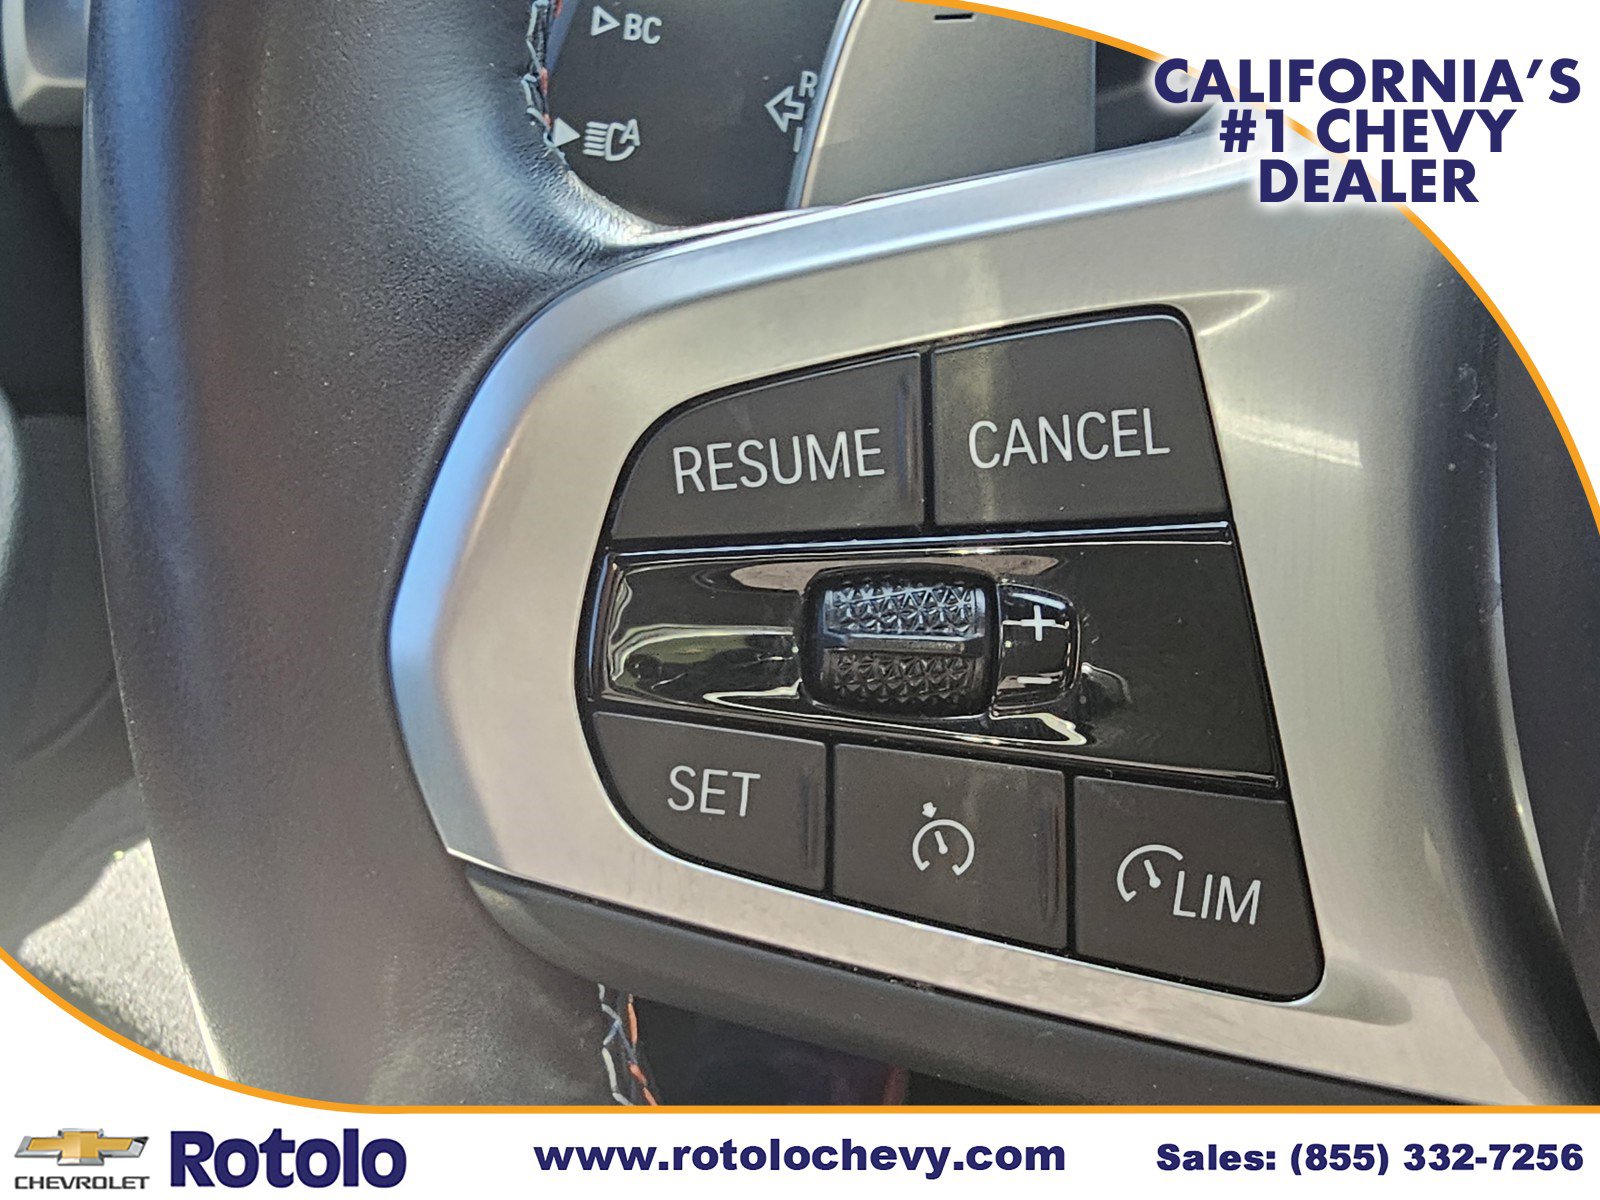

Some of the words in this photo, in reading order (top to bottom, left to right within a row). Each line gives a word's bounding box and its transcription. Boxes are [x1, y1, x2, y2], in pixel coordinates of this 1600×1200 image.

[623, 14, 662, 44] BC
[673, 427, 885, 495] RESUME
[967, 407, 1171, 471] CANCEL
[666, 765, 761, 818] SET
[1171, 869, 1262, 926] LIM
